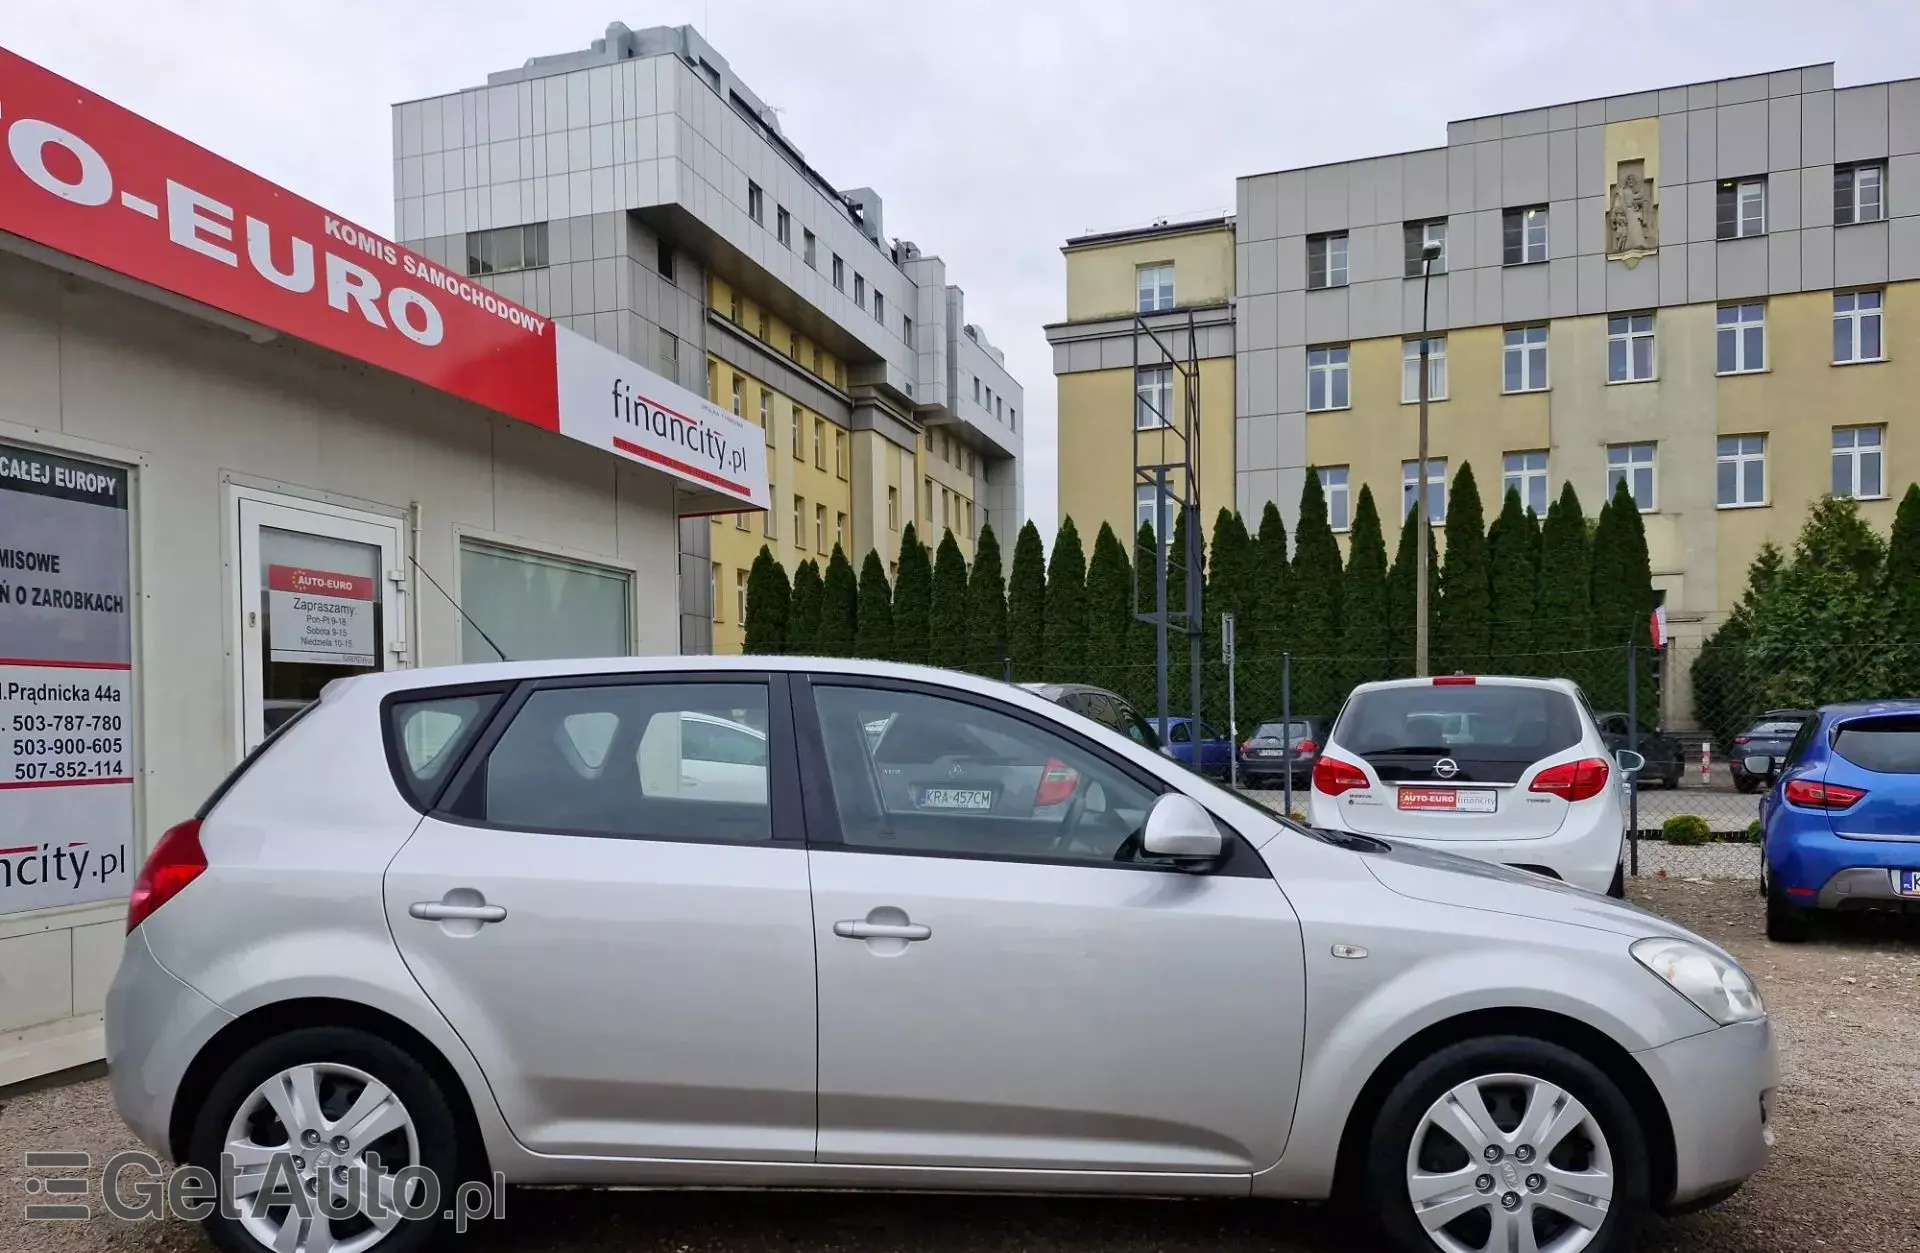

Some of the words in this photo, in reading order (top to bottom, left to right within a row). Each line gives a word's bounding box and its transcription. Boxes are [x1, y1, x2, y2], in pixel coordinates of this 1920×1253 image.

[324, 215, 398, 266] KOMIS
[403, 254, 545, 336] SAMOCHODOWY
[612, 378, 747, 474] financity.pl
[0, 456, 50, 484] CAŁEJ
[55, 467, 116, 496] EUROPY
[298, 575, 353, 591] AUTO-EURO
[15, 586, 27, 605] O
[32, 587, 124, 613] ZAROBKACH
[306, 625, 330, 636] Sobota
[300, 637, 332, 648] Niedziela
[94, 685, 121, 702] 44a
[12, 715, 121, 732] 503-787-780
[13, 738, 122, 756] 503-900-605
[15, 760, 122, 780] 507-852-114
[927, 791, 948, 804] KRA
[953, 791, 990, 805] 457CM
[1404, 794, 1455, 803] AUTO-EURO
[0, 843, 125, 889] ncity.pl
